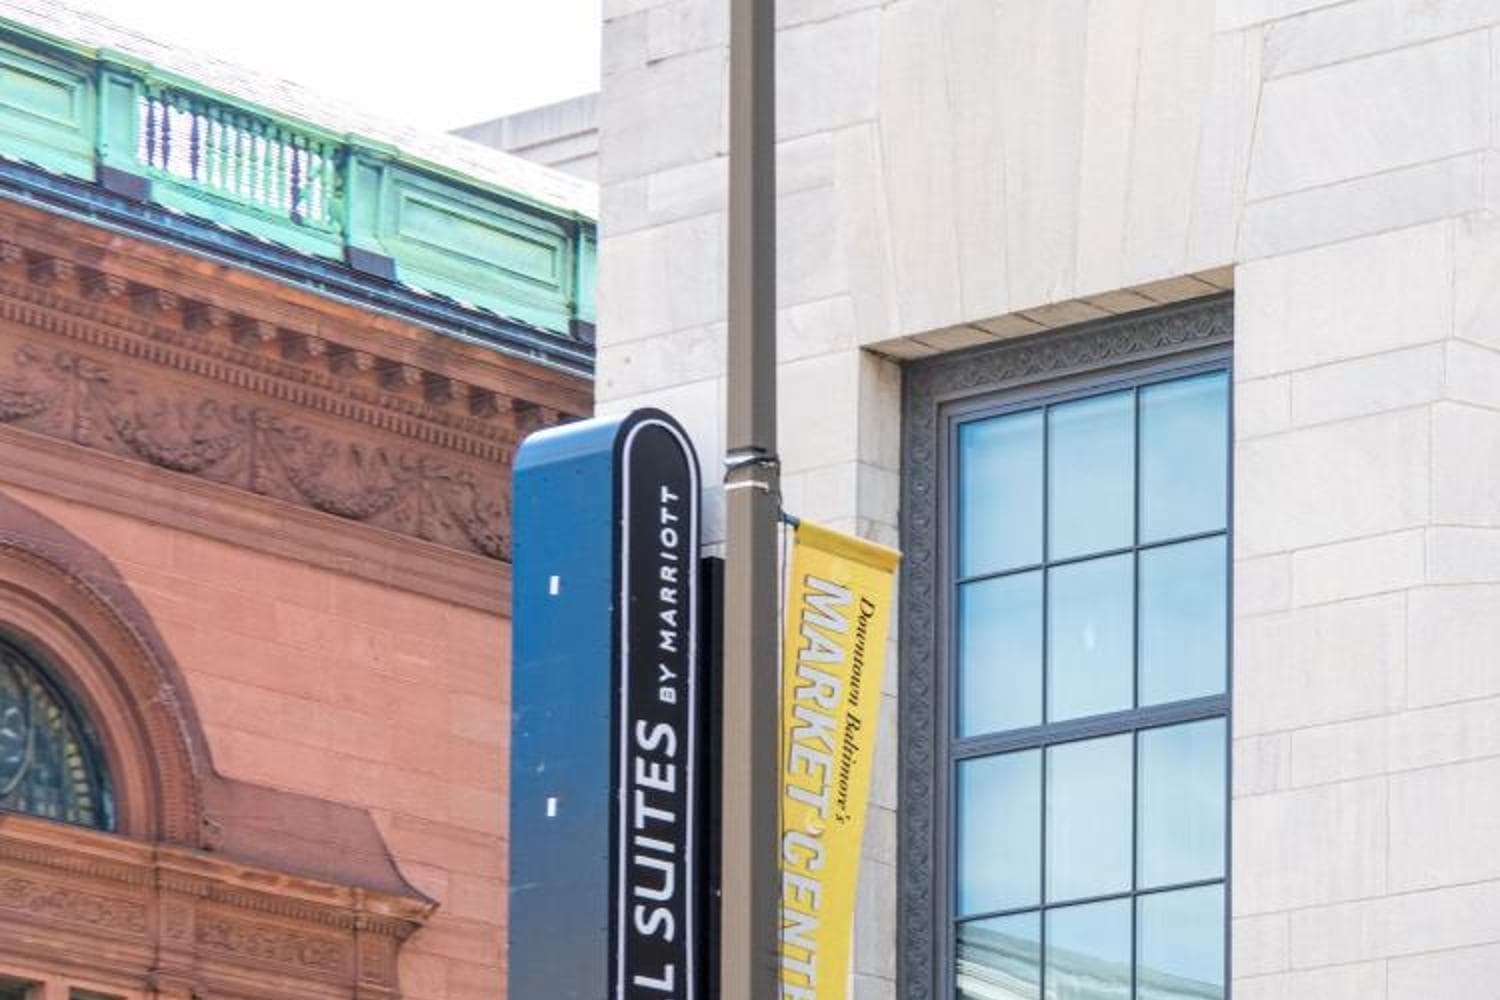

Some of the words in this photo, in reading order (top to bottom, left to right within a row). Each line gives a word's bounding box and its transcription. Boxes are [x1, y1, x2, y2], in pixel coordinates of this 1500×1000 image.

[659, 486, 680, 653] MARRIOTT
[659, 664, 678, 704] BY
[786, 574, 854, 820] MARKET
[848, 597, 876, 708] Downtown
[633, 719, 678, 942] SUITES
[834, 711, 863, 825] Baltimore's
